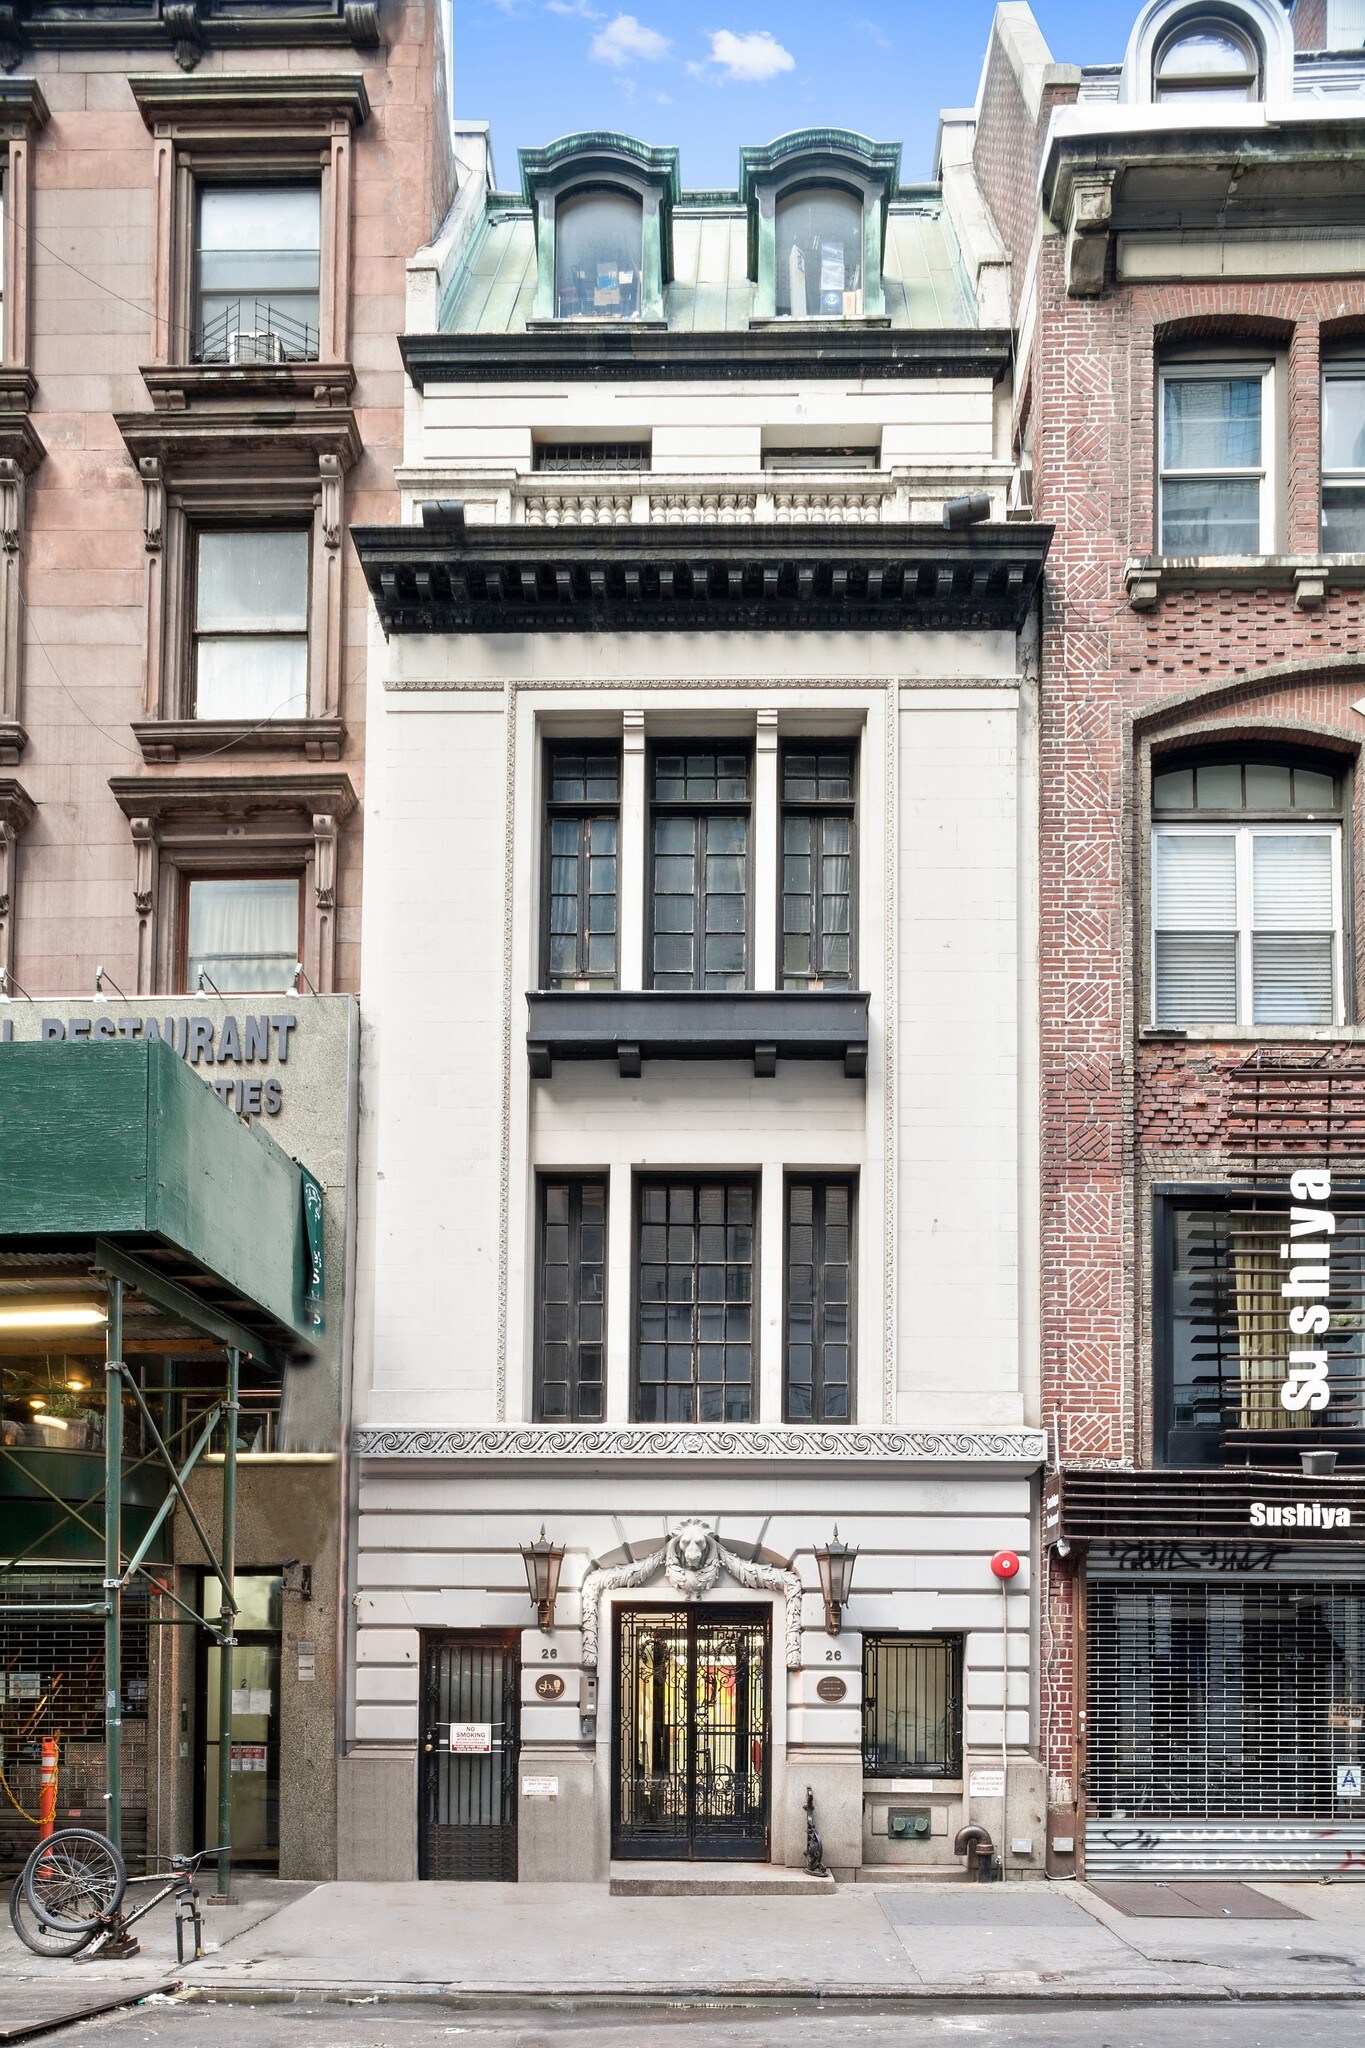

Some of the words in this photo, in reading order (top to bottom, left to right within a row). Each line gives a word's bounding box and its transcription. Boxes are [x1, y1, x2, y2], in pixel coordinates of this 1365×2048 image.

[1280, 1169, 1336, 1411] Sushiya
[1249, 1502, 1351, 1530] Sushiya
[541, 1648, 558, 1659] 26
[825, 1650, 842, 1661] 26
[1341, 1769, 1357, 1788] A
